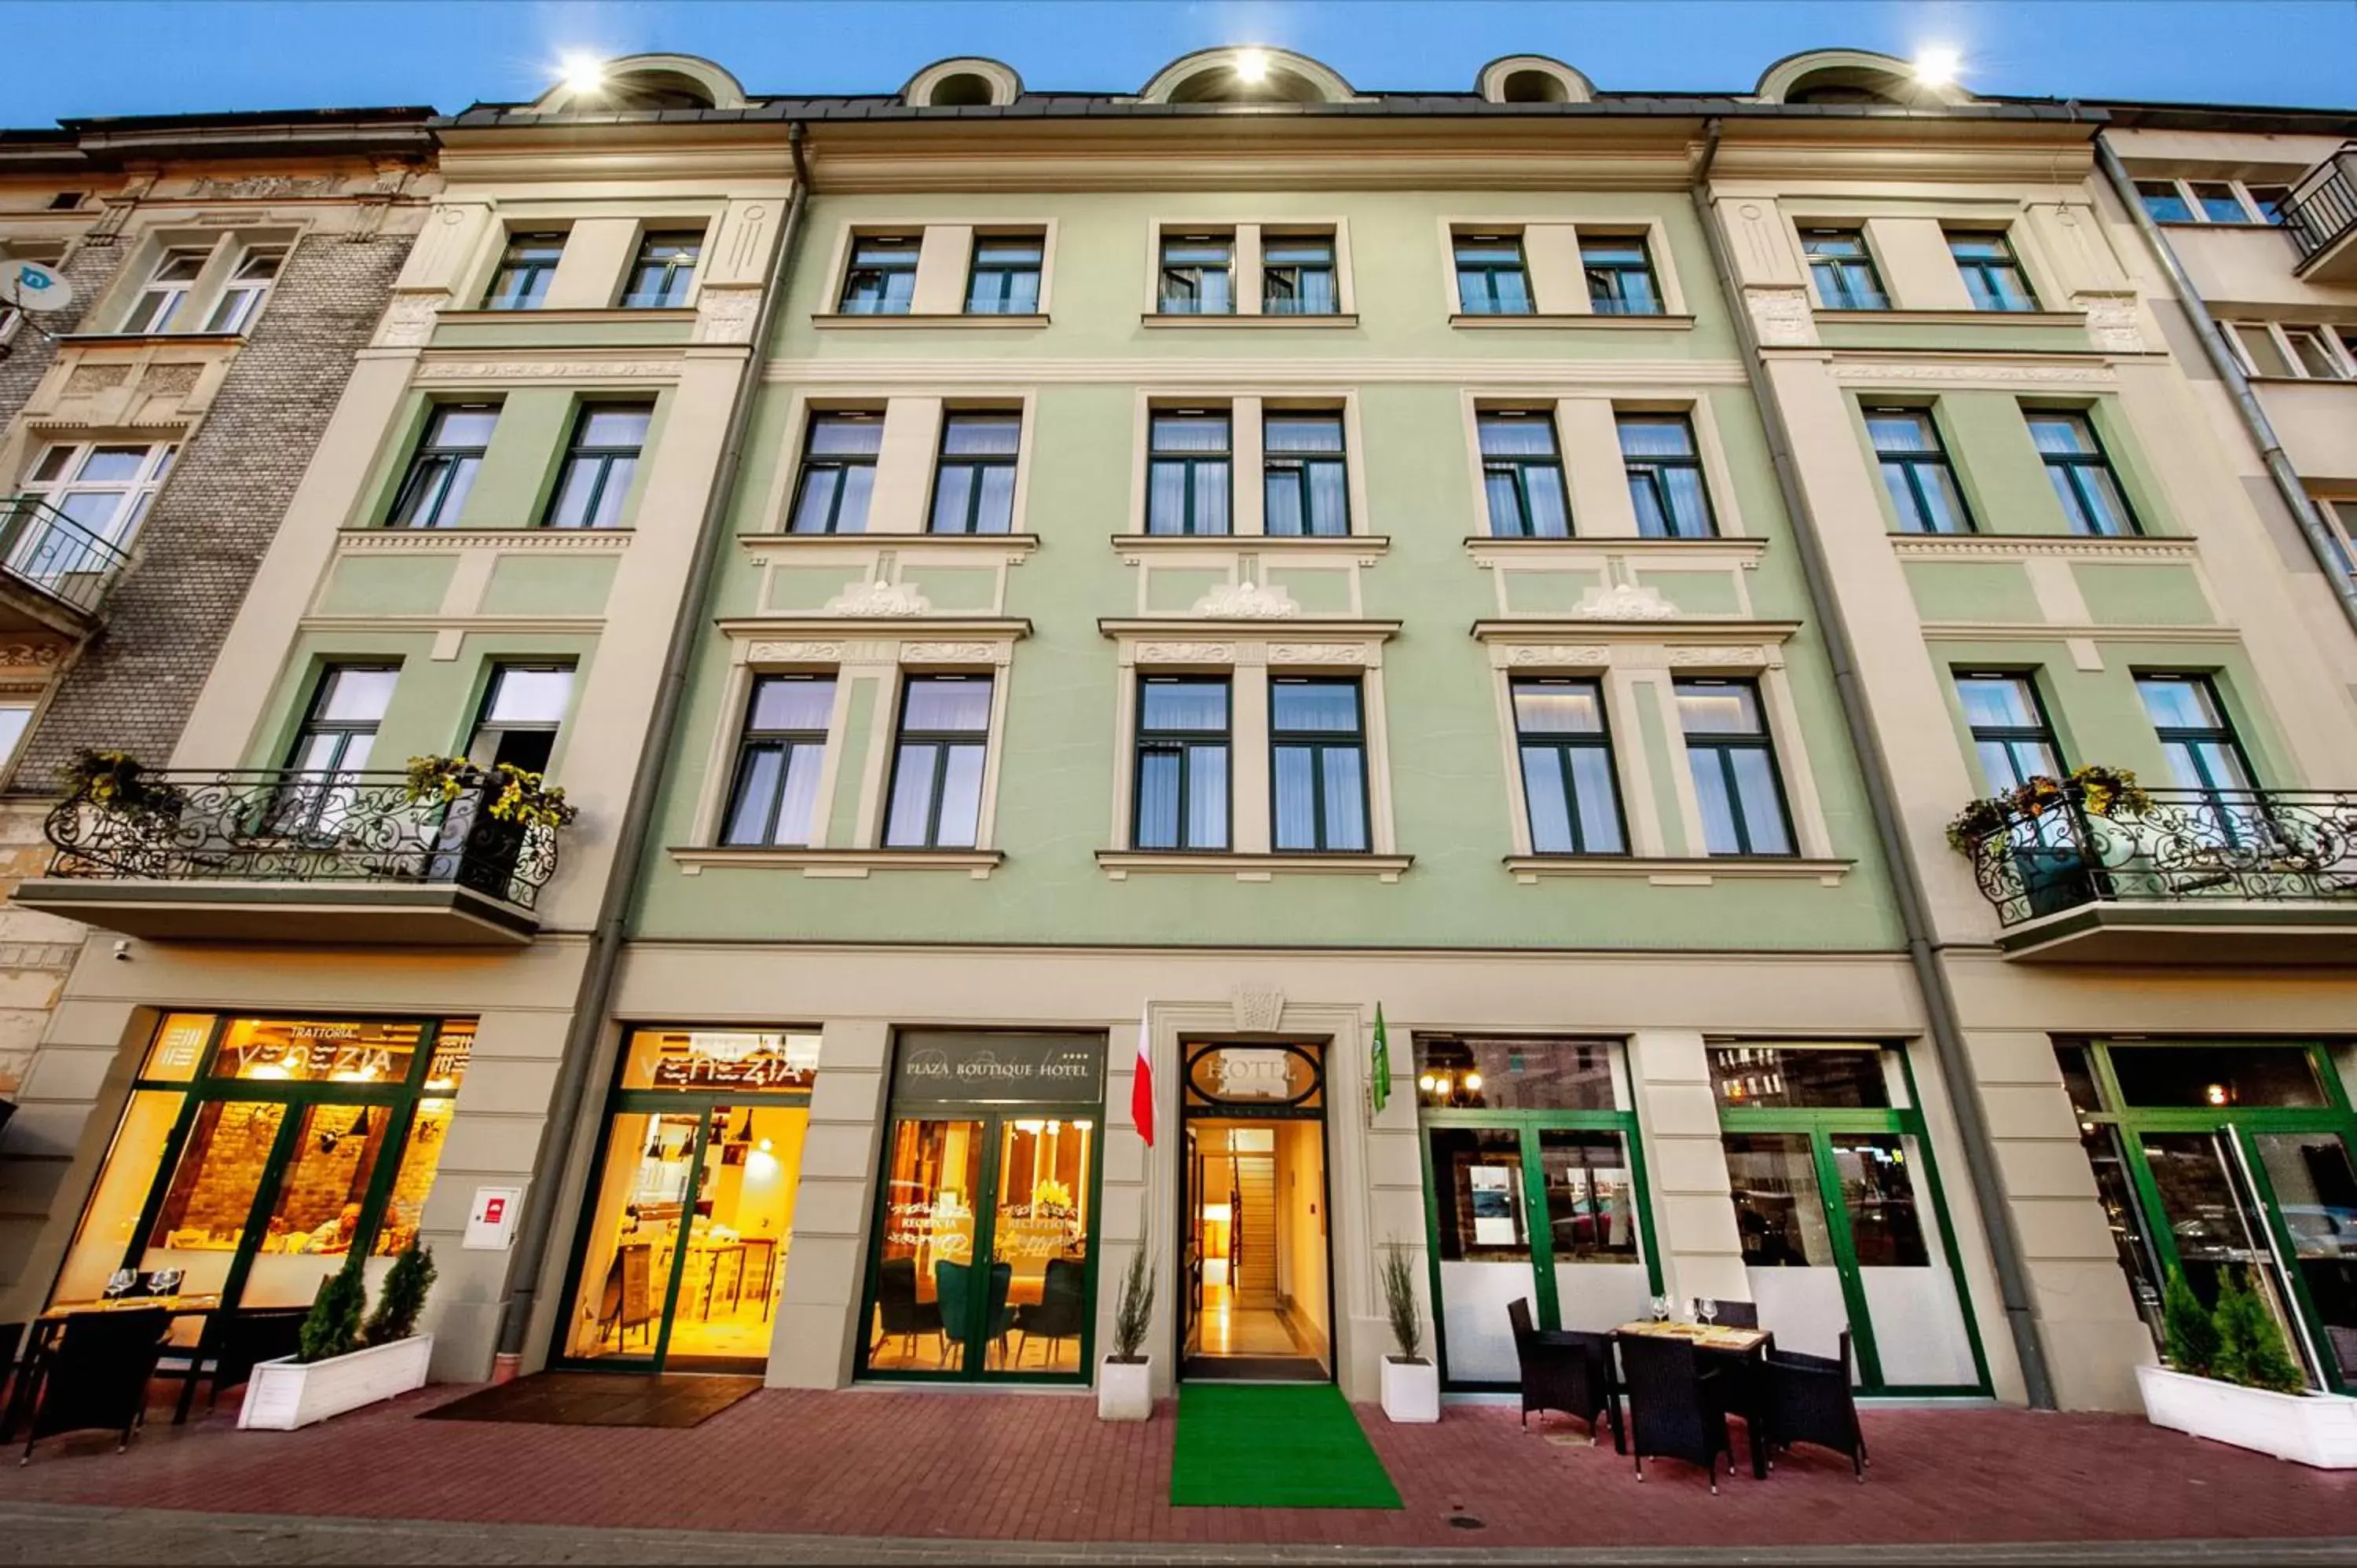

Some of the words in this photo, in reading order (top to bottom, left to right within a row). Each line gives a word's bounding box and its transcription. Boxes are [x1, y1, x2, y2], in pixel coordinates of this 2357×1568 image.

[291, 1026, 356, 1039] TRATTORIA
[906, 1063, 949, 1075] PLAZA
[956, 1064, 1032, 1078] BOUTIQUE
[1039, 1064, 1088, 1077] HOTEL
[1206, 1060, 1297, 1081] HOTEL
